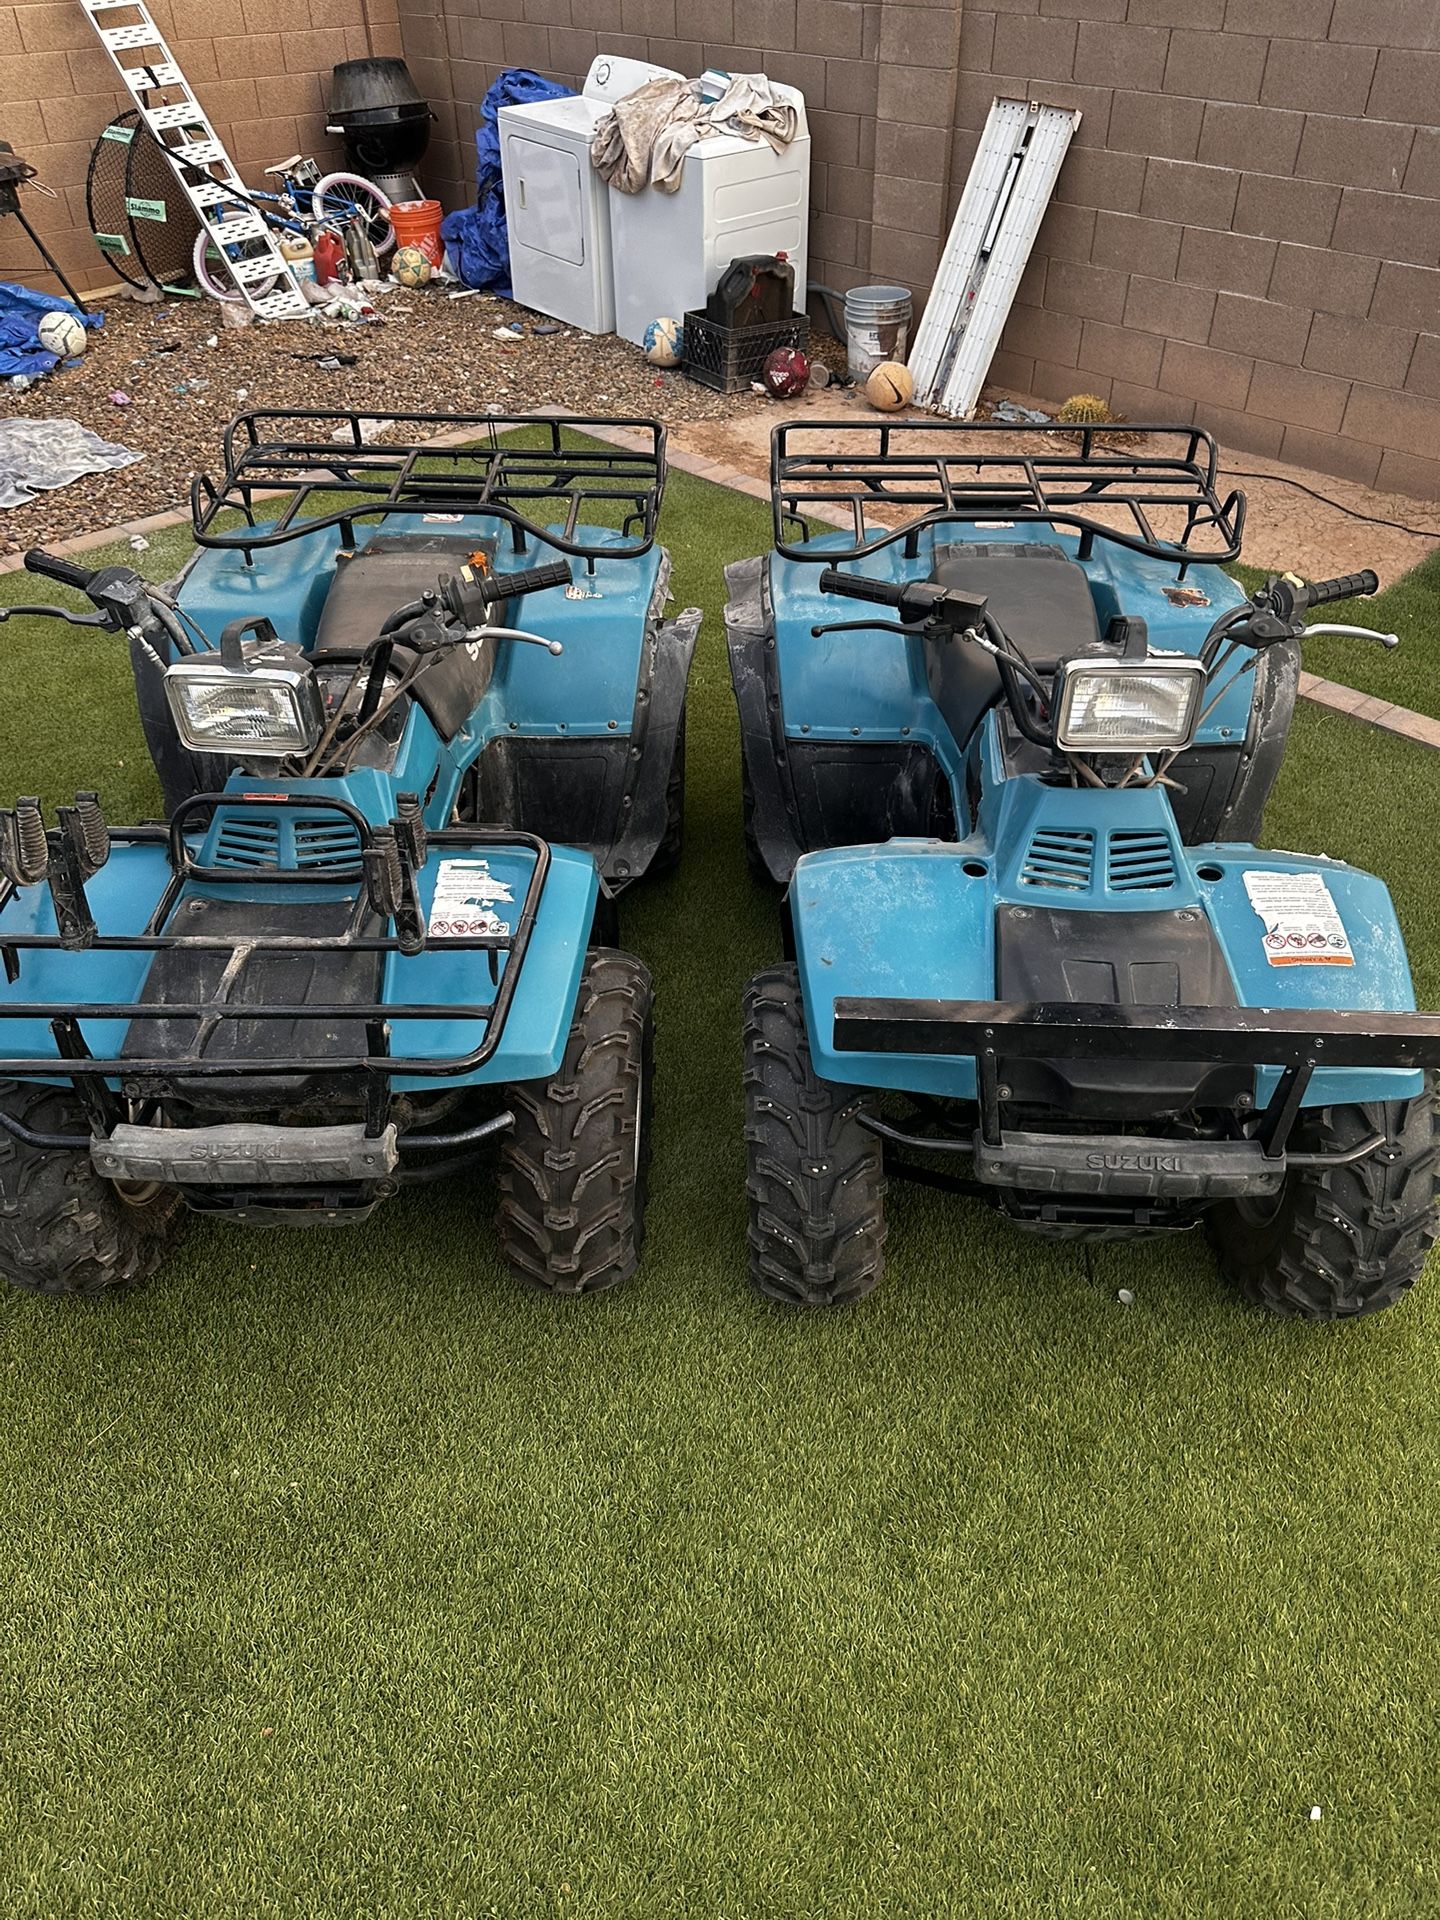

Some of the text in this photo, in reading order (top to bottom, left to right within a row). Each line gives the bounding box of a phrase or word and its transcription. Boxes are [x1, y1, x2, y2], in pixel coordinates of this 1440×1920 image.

[130, 203, 161, 215] Slammo
[190, 1143, 281, 1160] SUZUKI
[1087, 1153, 1181, 1172] SUZUKI
